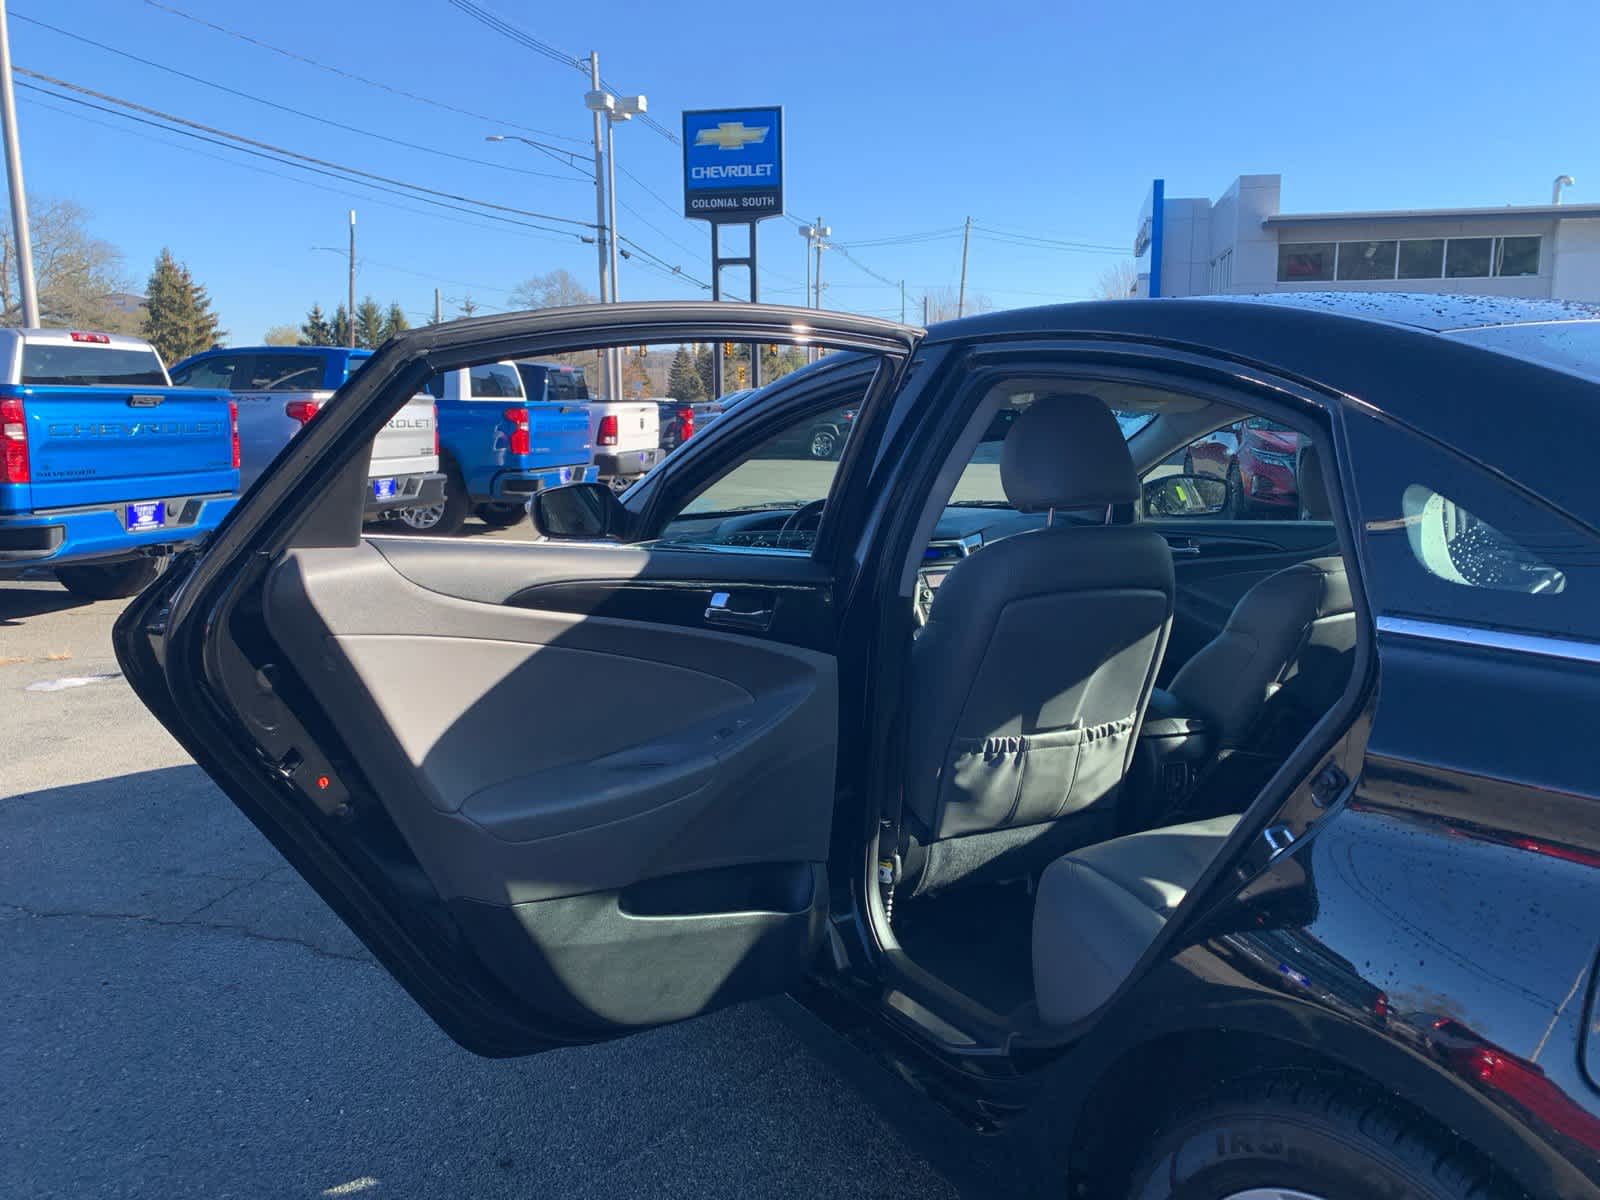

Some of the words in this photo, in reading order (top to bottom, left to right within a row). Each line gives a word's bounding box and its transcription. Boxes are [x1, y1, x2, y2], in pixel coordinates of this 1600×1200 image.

[692, 164, 773, 179] CHEVROLET
[691, 198, 739, 209] COLONIAL
[742, 196, 775, 207] SOUTH
[48, 421, 224, 438] CHEVROLET
[387, 418, 429, 429] ROLET
